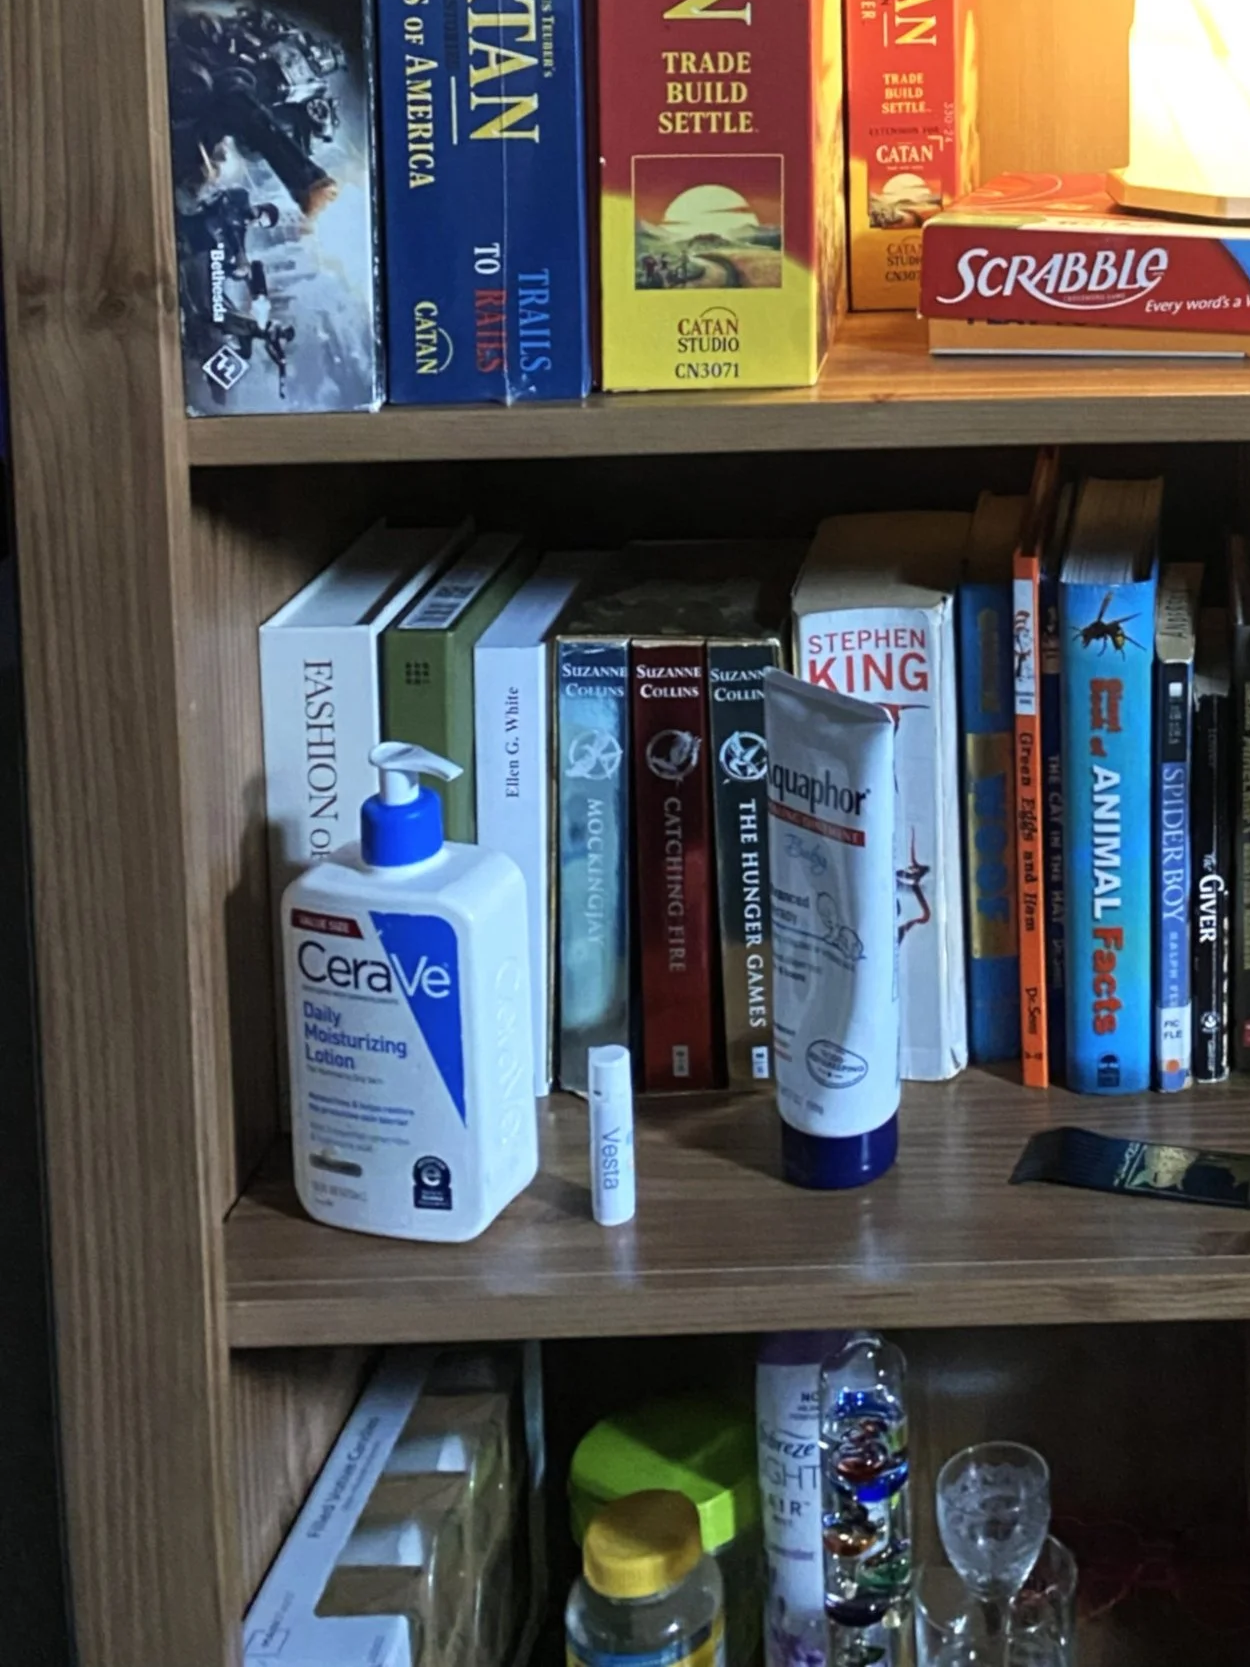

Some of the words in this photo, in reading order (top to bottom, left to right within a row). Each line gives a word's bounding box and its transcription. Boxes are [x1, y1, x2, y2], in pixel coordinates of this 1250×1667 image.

[403, 16, 424, 46] OF
[662, 51, 752, 74] TRADE
[882, 72, 924, 85] TRADE
[666, 81, 748, 104] BUILD
[881, 102, 926, 115] SETTLE
[884, 87, 924, 99] BUILD
[404, 53, 439, 190] AMERICA
[658, 111, 754, 134] SETTLE
[875, 144, 934, 165] CATAN
[473, 242, 501, 276] TO
[208, 244, 228, 323] Bethesda
[936, 247, 1169, 310] SCRABBLE
[517, 268, 553, 372] TRAILS
[1144, 298, 1183, 315] Every
[1186, 294, 1231, 311] word's
[1233, 298, 1242, 309] a
[413, 300, 438, 375] CATAN
[473, 288, 509, 374] RAILS
[677, 318, 739, 336] CATAN
[677, 336, 740, 353] STUDIO
[674, 362, 740, 379] CN3071
[807, 628, 926, 655] STEPHEN
[561, 662, 629, 678] SUZANNE
[635, 663, 703, 679] SUZANNE
[710, 667, 765, 683] SUZANN
[808, 651, 929, 693] KING
[565, 683, 625, 698] COLLINS
[639, 683, 701, 699] COLLINS
[713, 687, 765, 702] COLLIN
[505, 686, 520, 734] White
[303, 660, 339, 822] FASHION
[505, 735, 520, 756] G.
[1018, 732, 1034, 786] Green
[1048, 754, 1060, 783] THE
[505, 759, 520, 799] Ellen
[767, 764, 867, 816] quaphor
[738, 797, 759, 845] THE
[1018, 798, 1037, 842] Eggs
[1048, 791, 1061, 823] CAT
[1050, 830, 1062, 848] IN
[1092, 764, 1123, 920] ANIMAL
[584, 797, 605, 944] MOCKINGJAY
[663, 795, 685, 918] CATCHING
[1022, 850, 1038, 882] and
[1050, 854, 1063, 882] THE
[741, 852, 763, 948] HUNGER
[1023, 892, 1038, 932] Ham
[1052, 890, 1065, 924] HAT
[1197, 874, 1225, 945] GIVER
[667, 925, 687, 973] FIRE
[1168, 931, 1180, 979] RALPH
[298, 940, 451, 998] CeraVe
[1092, 925, 1125, 1036] Facts
[746, 952, 767, 1028] GAMES
[303, 1001, 341, 1028] Daily
[1163, 1019, 1180, 1028] FIC
[303, 1022, 408, 1059] Moisturizing
[1163, 1030, 1183, 1040] FLE
[305, 1044, 355, 1070] Lotion
[602, 1127, 622, 1190] Vesta
